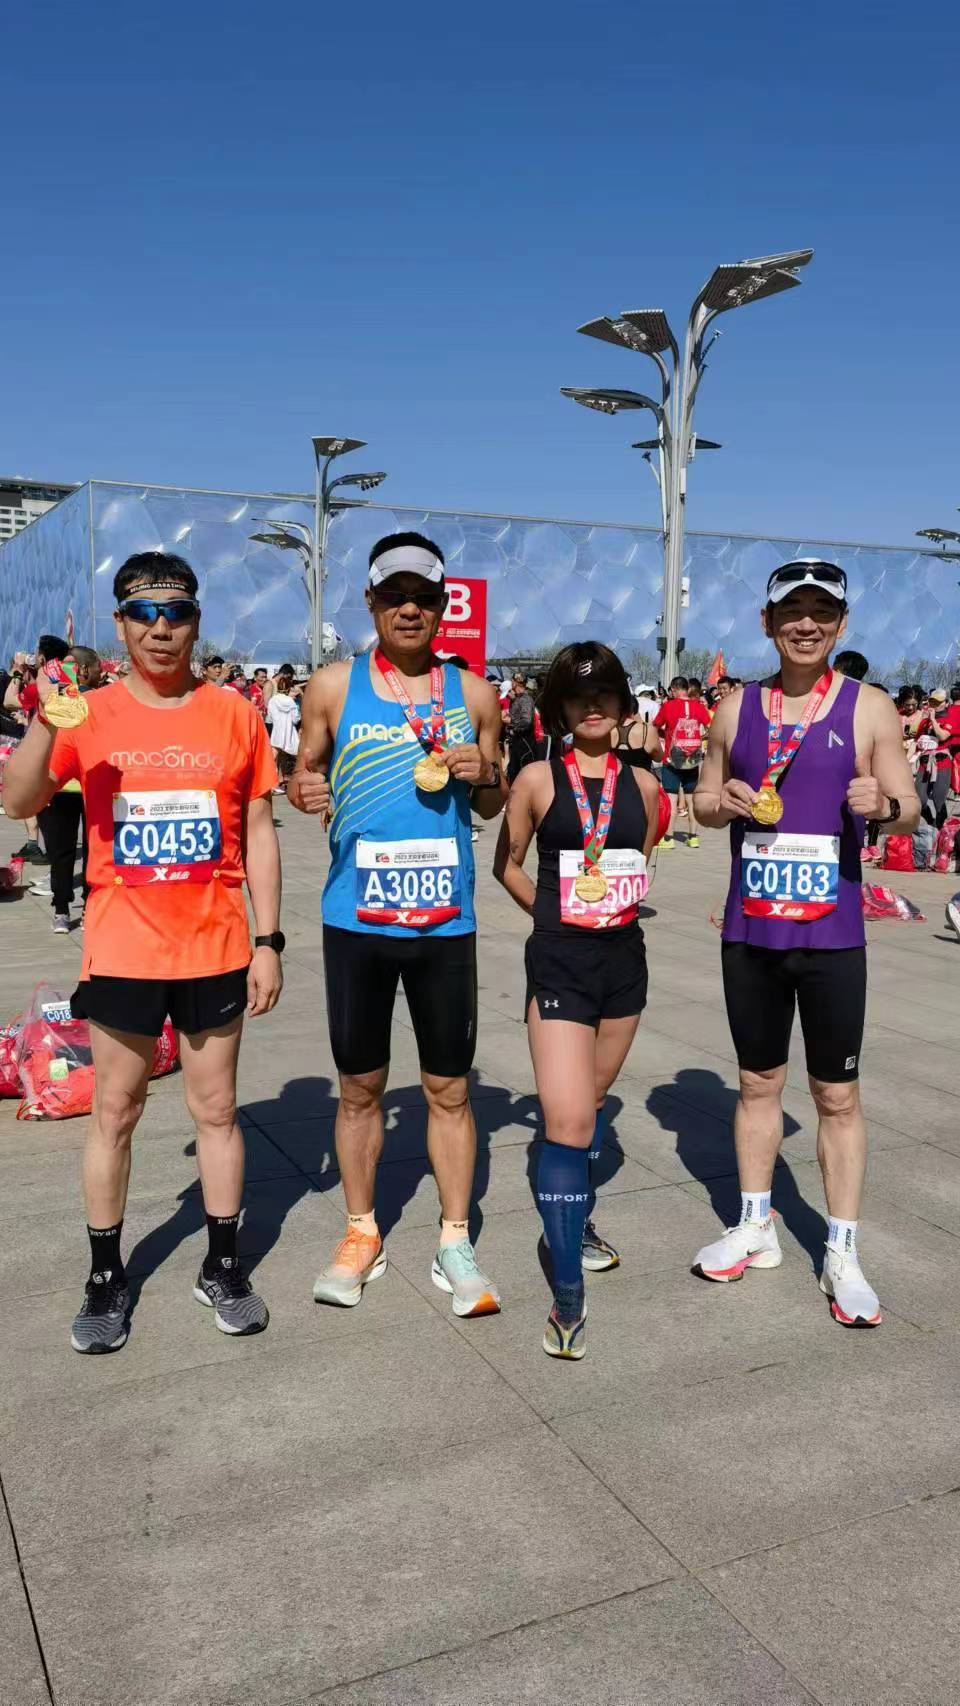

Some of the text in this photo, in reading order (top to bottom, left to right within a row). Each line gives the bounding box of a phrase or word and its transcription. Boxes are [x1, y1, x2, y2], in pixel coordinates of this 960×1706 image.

[442, 583, 472, 622] B
[110, 751, 224, 769] macondo
[119, 821, 214, 858] C0453
[364, 869, 453, 902] A3086
[567, 878, 643, 908] A500
[746, 861, 830, 896] C0183
[537, 1192, 589, 1202] SSPORT
